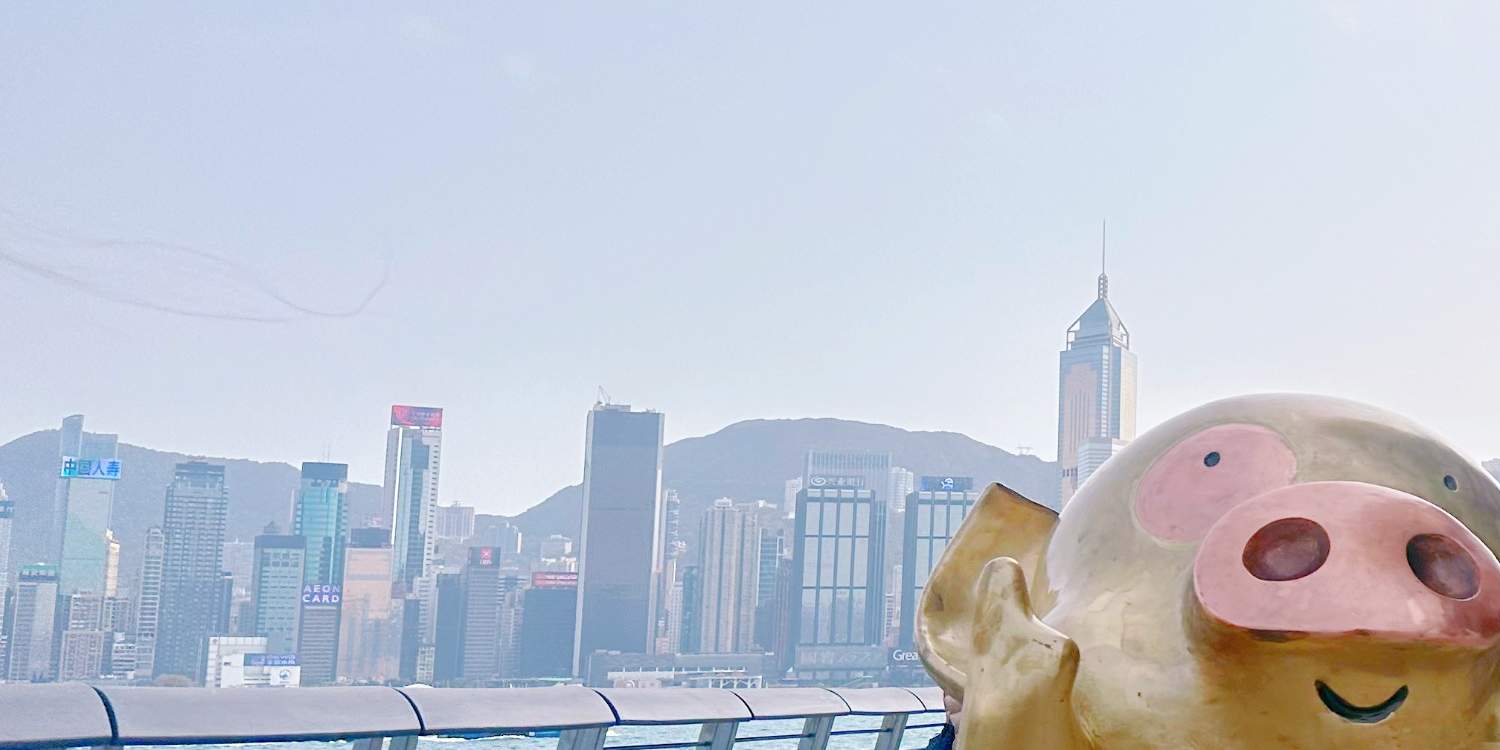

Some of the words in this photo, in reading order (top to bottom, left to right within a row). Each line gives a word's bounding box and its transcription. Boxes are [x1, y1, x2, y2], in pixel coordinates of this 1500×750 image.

[64, 458, 120, 476] 中国人寿
[304, 584, 340, 593] AEON
[302, 594, 340, 603] CARD
